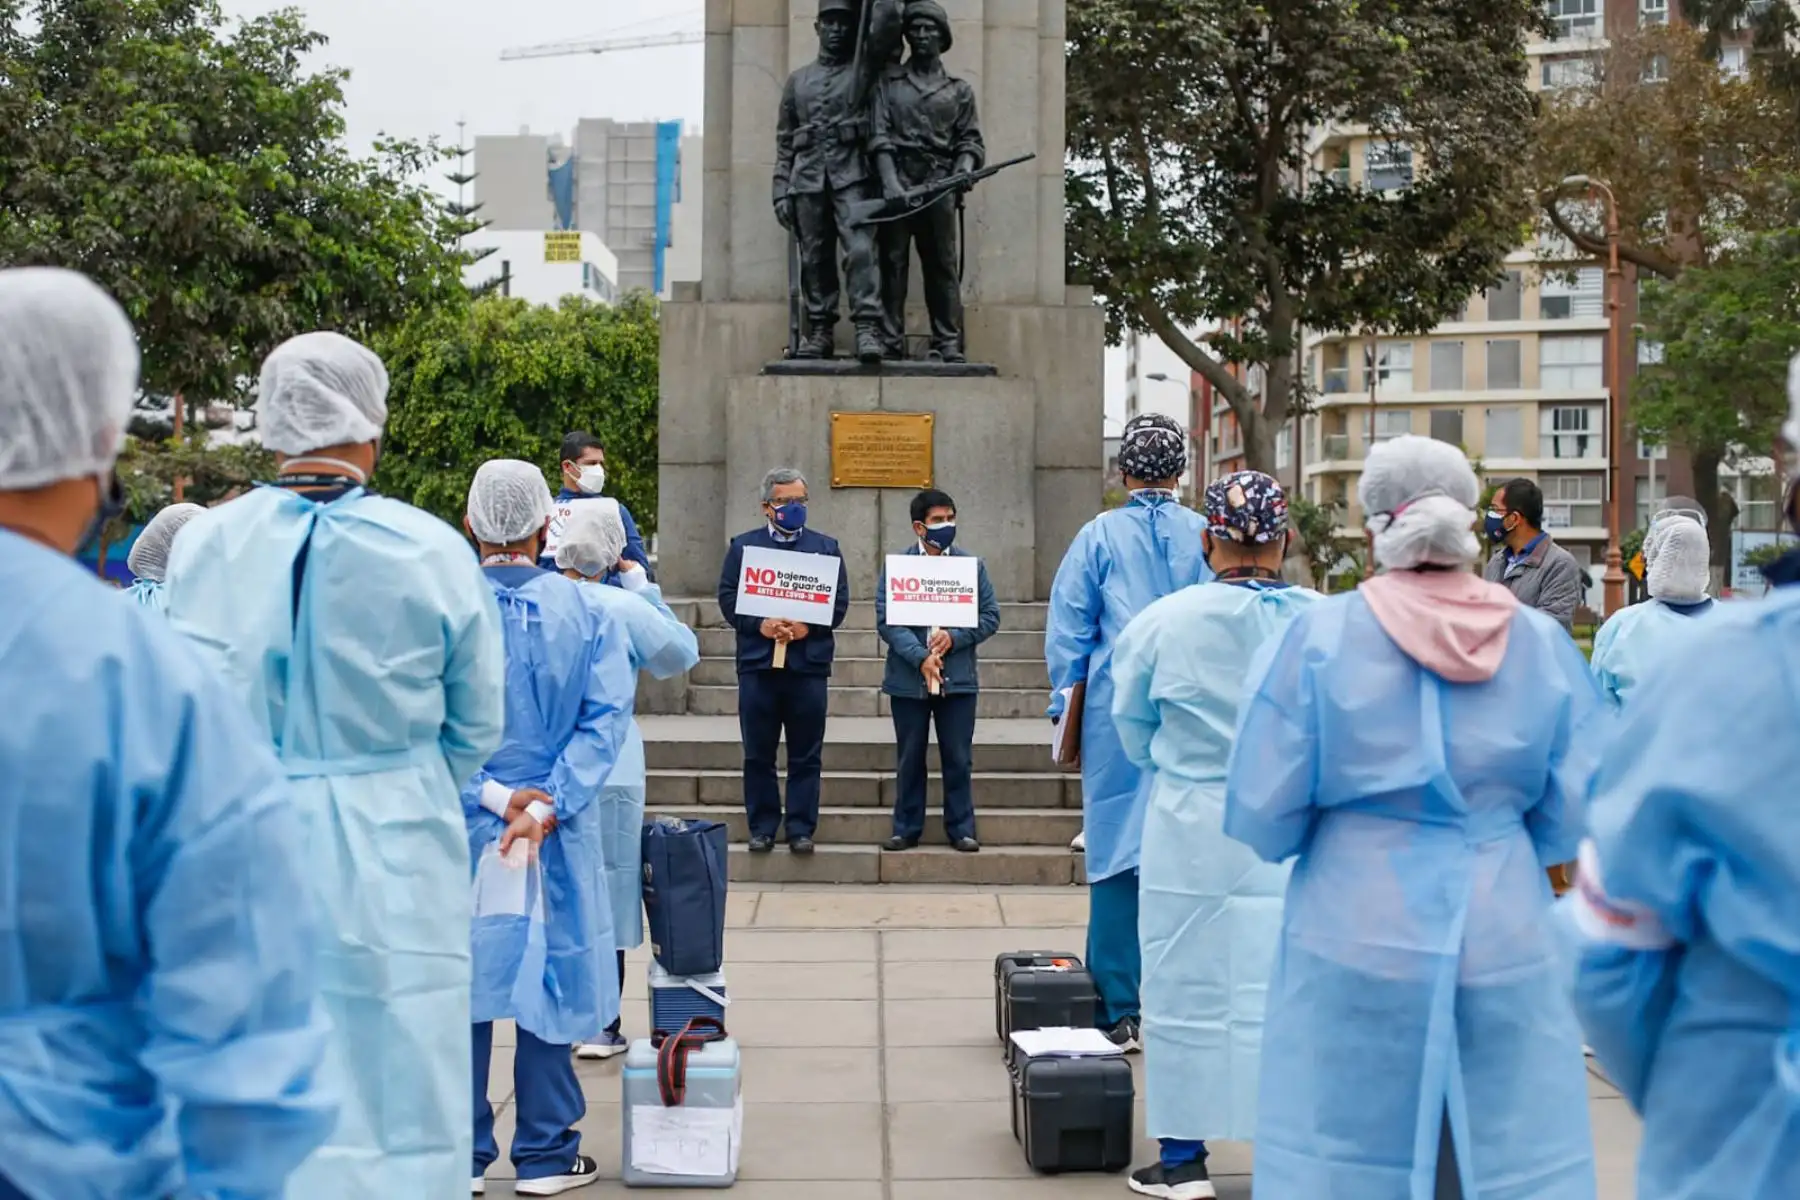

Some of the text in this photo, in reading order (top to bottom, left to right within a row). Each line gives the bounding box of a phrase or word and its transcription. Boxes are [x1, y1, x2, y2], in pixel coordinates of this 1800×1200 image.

[558, 508, 571, 517] Yo
[746, 567, 818, 584] NO bajemos
[792, 582, 832, 592] guardia
[891, 577, 960, 592] NO bajemos
[936, 586, 974, 594] guardia
[786, 592, 814, 600] COVID-19
